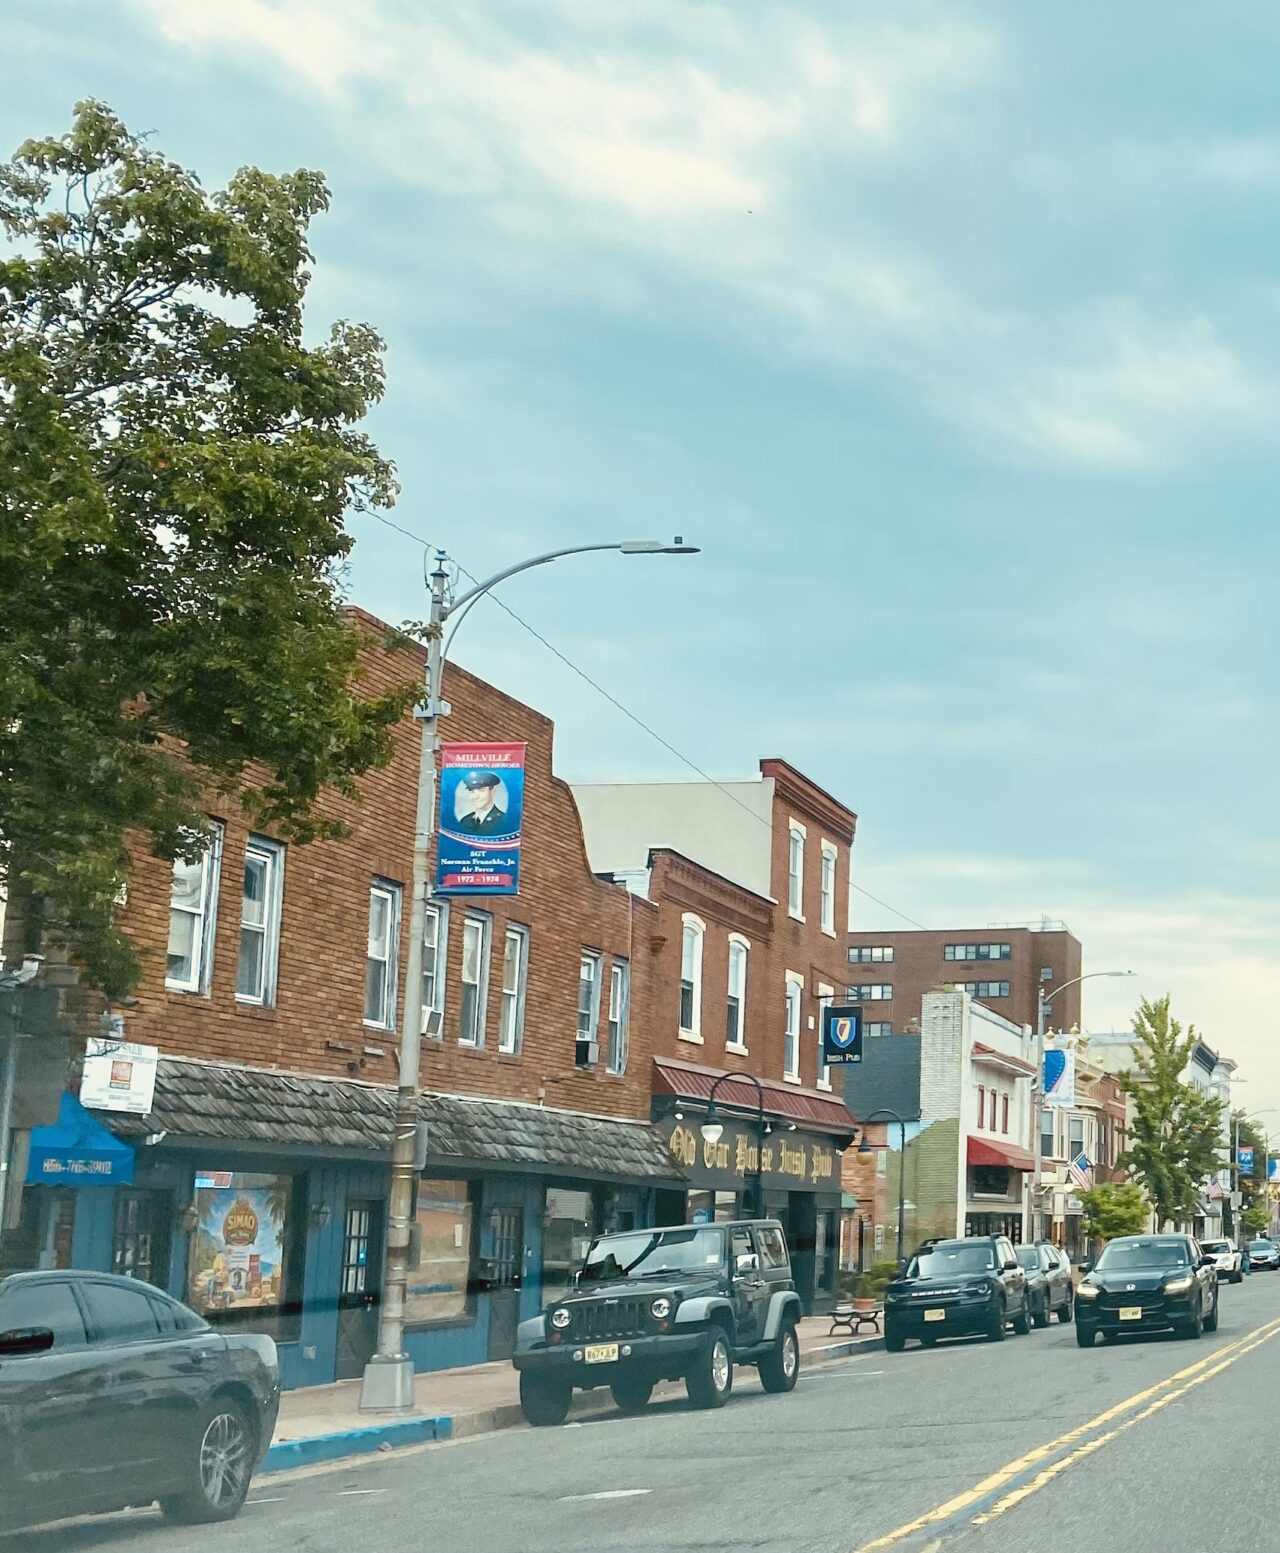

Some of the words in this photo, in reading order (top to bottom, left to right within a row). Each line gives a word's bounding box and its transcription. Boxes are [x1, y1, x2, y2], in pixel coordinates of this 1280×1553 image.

[456, 753, 511, 762] MILLVILLE
[669, 1125, 696, 1167] Old
[778, 1139, 807, 1182] Irish
[812, 1145, 832, 1184] Pub
[227, 1214, 255, 1230] SIMAO
